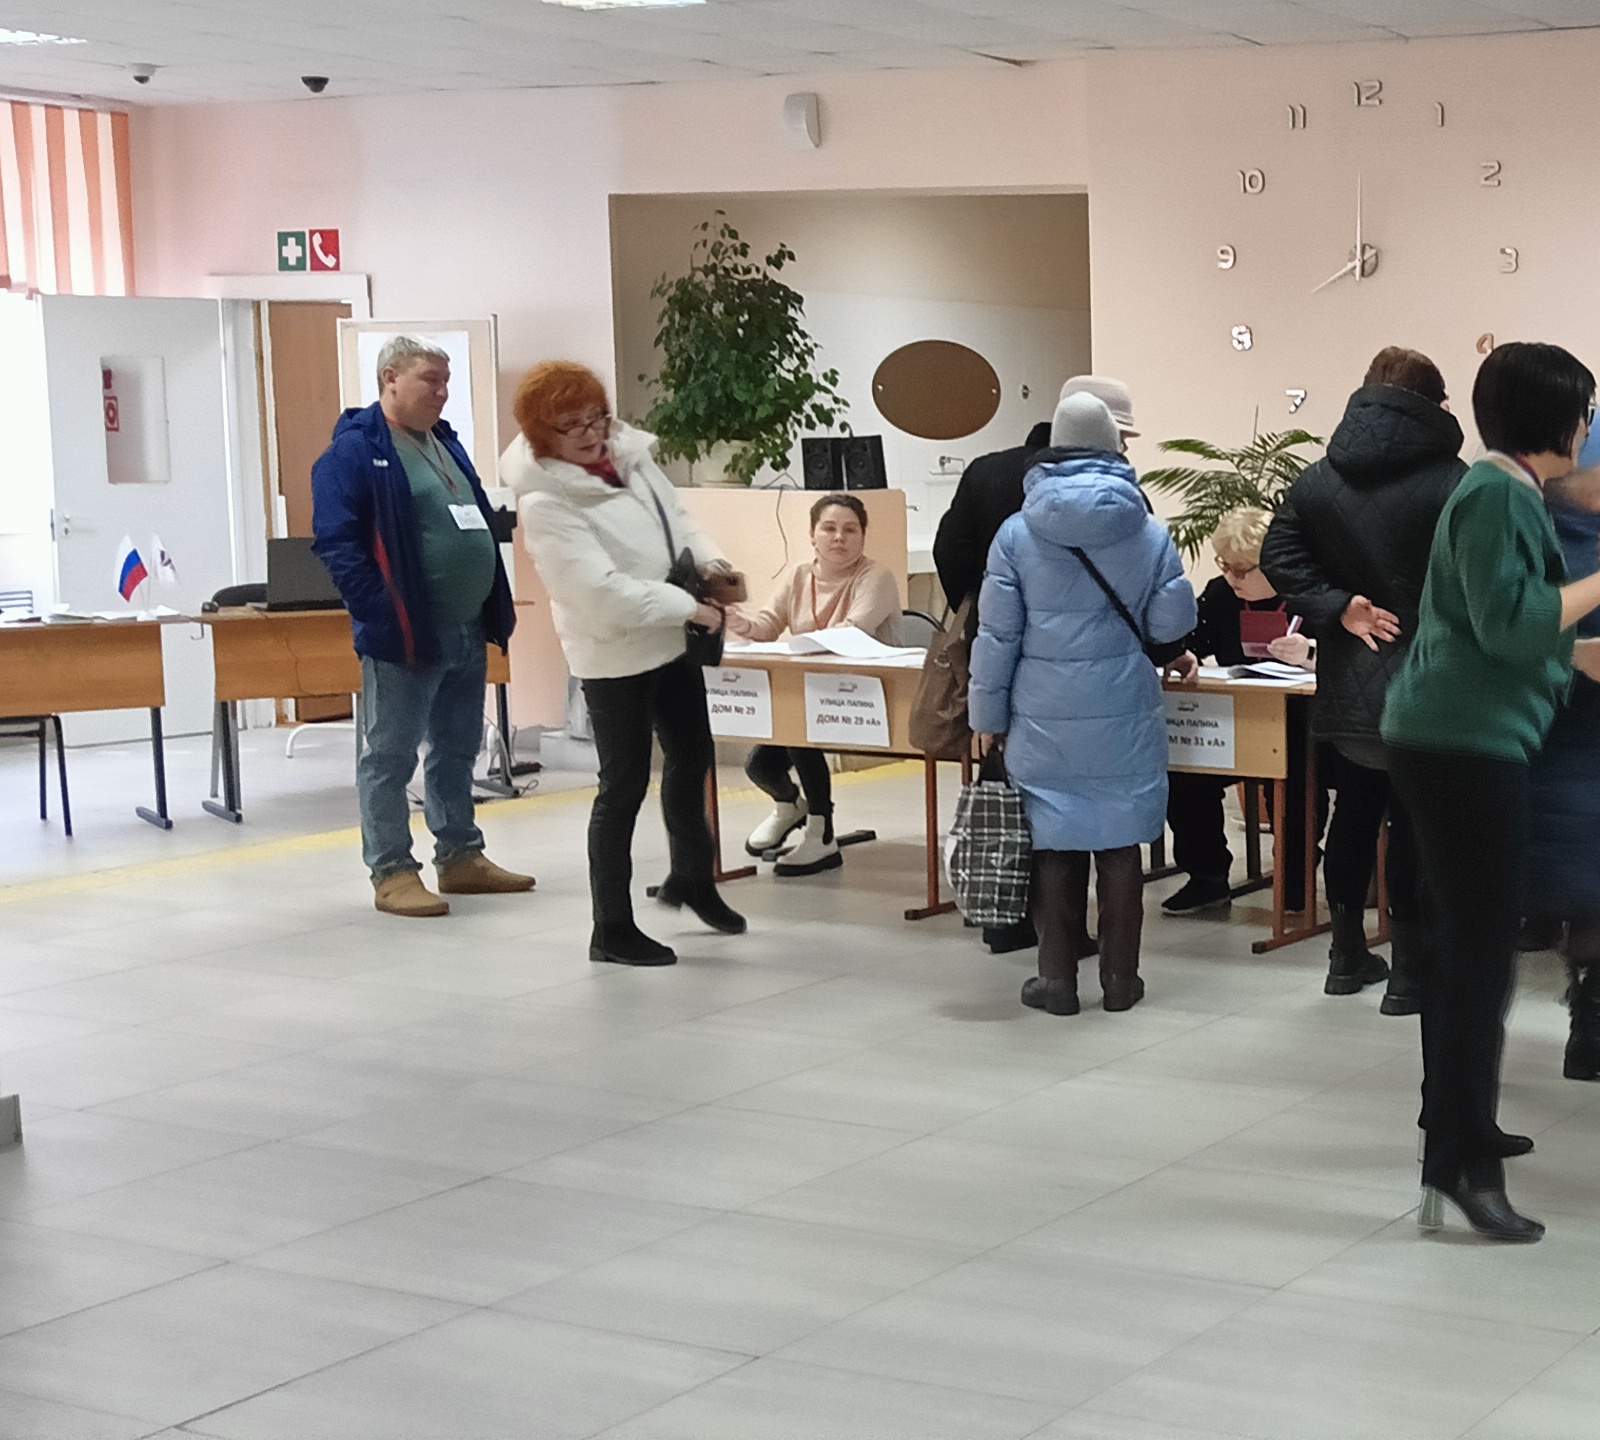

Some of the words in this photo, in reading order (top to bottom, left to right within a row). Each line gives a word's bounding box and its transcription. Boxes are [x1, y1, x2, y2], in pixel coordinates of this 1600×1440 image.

[1353, 79, 1383, 107] 12
[1287, 103, 1307, 130] 11
[1434, 101, 1445, 128] 1
[1237, 168, 1266, 195] 10
[1480, 160, 1502, 188] 2
[1216, 244, 1237, 270] 9
[1500, 246, 1519, 274] 3
[1230, 324, 1253, 350] 8
[1285, 388, 1307, 414] 7
[711, 703, 733, 714] ДОМ
[746, 705, 757, 715] 29
[816, 713, 840, 725] ДОМ
[854, 716, 865, 726] 29
